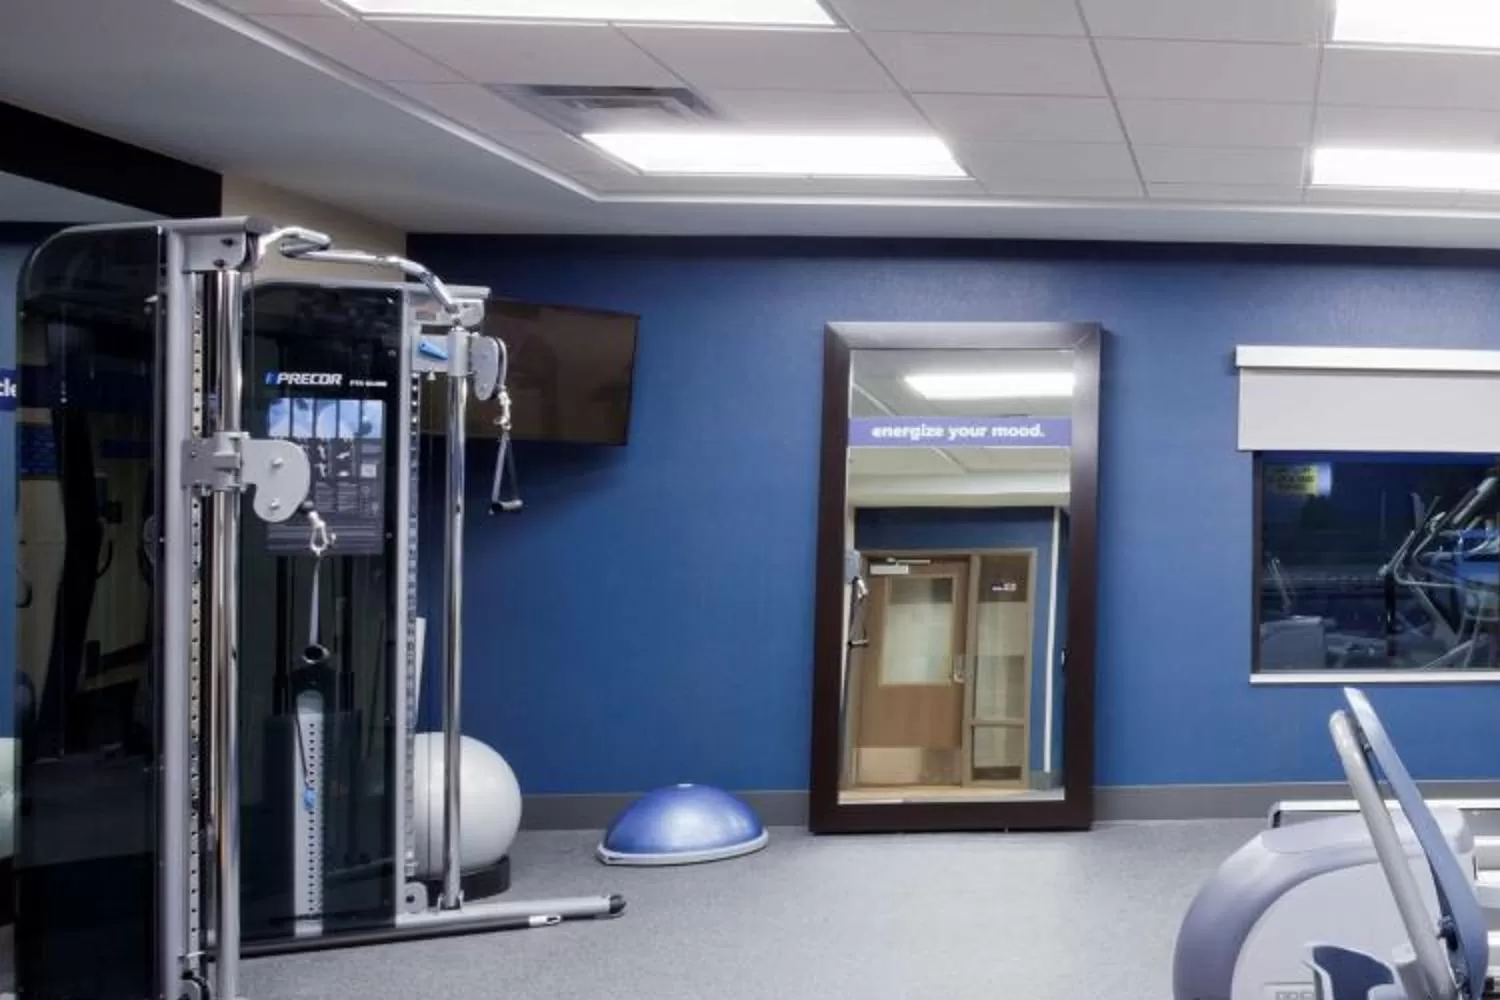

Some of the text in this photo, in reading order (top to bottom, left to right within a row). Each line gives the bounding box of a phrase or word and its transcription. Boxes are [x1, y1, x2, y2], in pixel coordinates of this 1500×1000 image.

[276, 372, 343, 386] PRECOR
[871, 423, 1046, 441] energize your mood.
